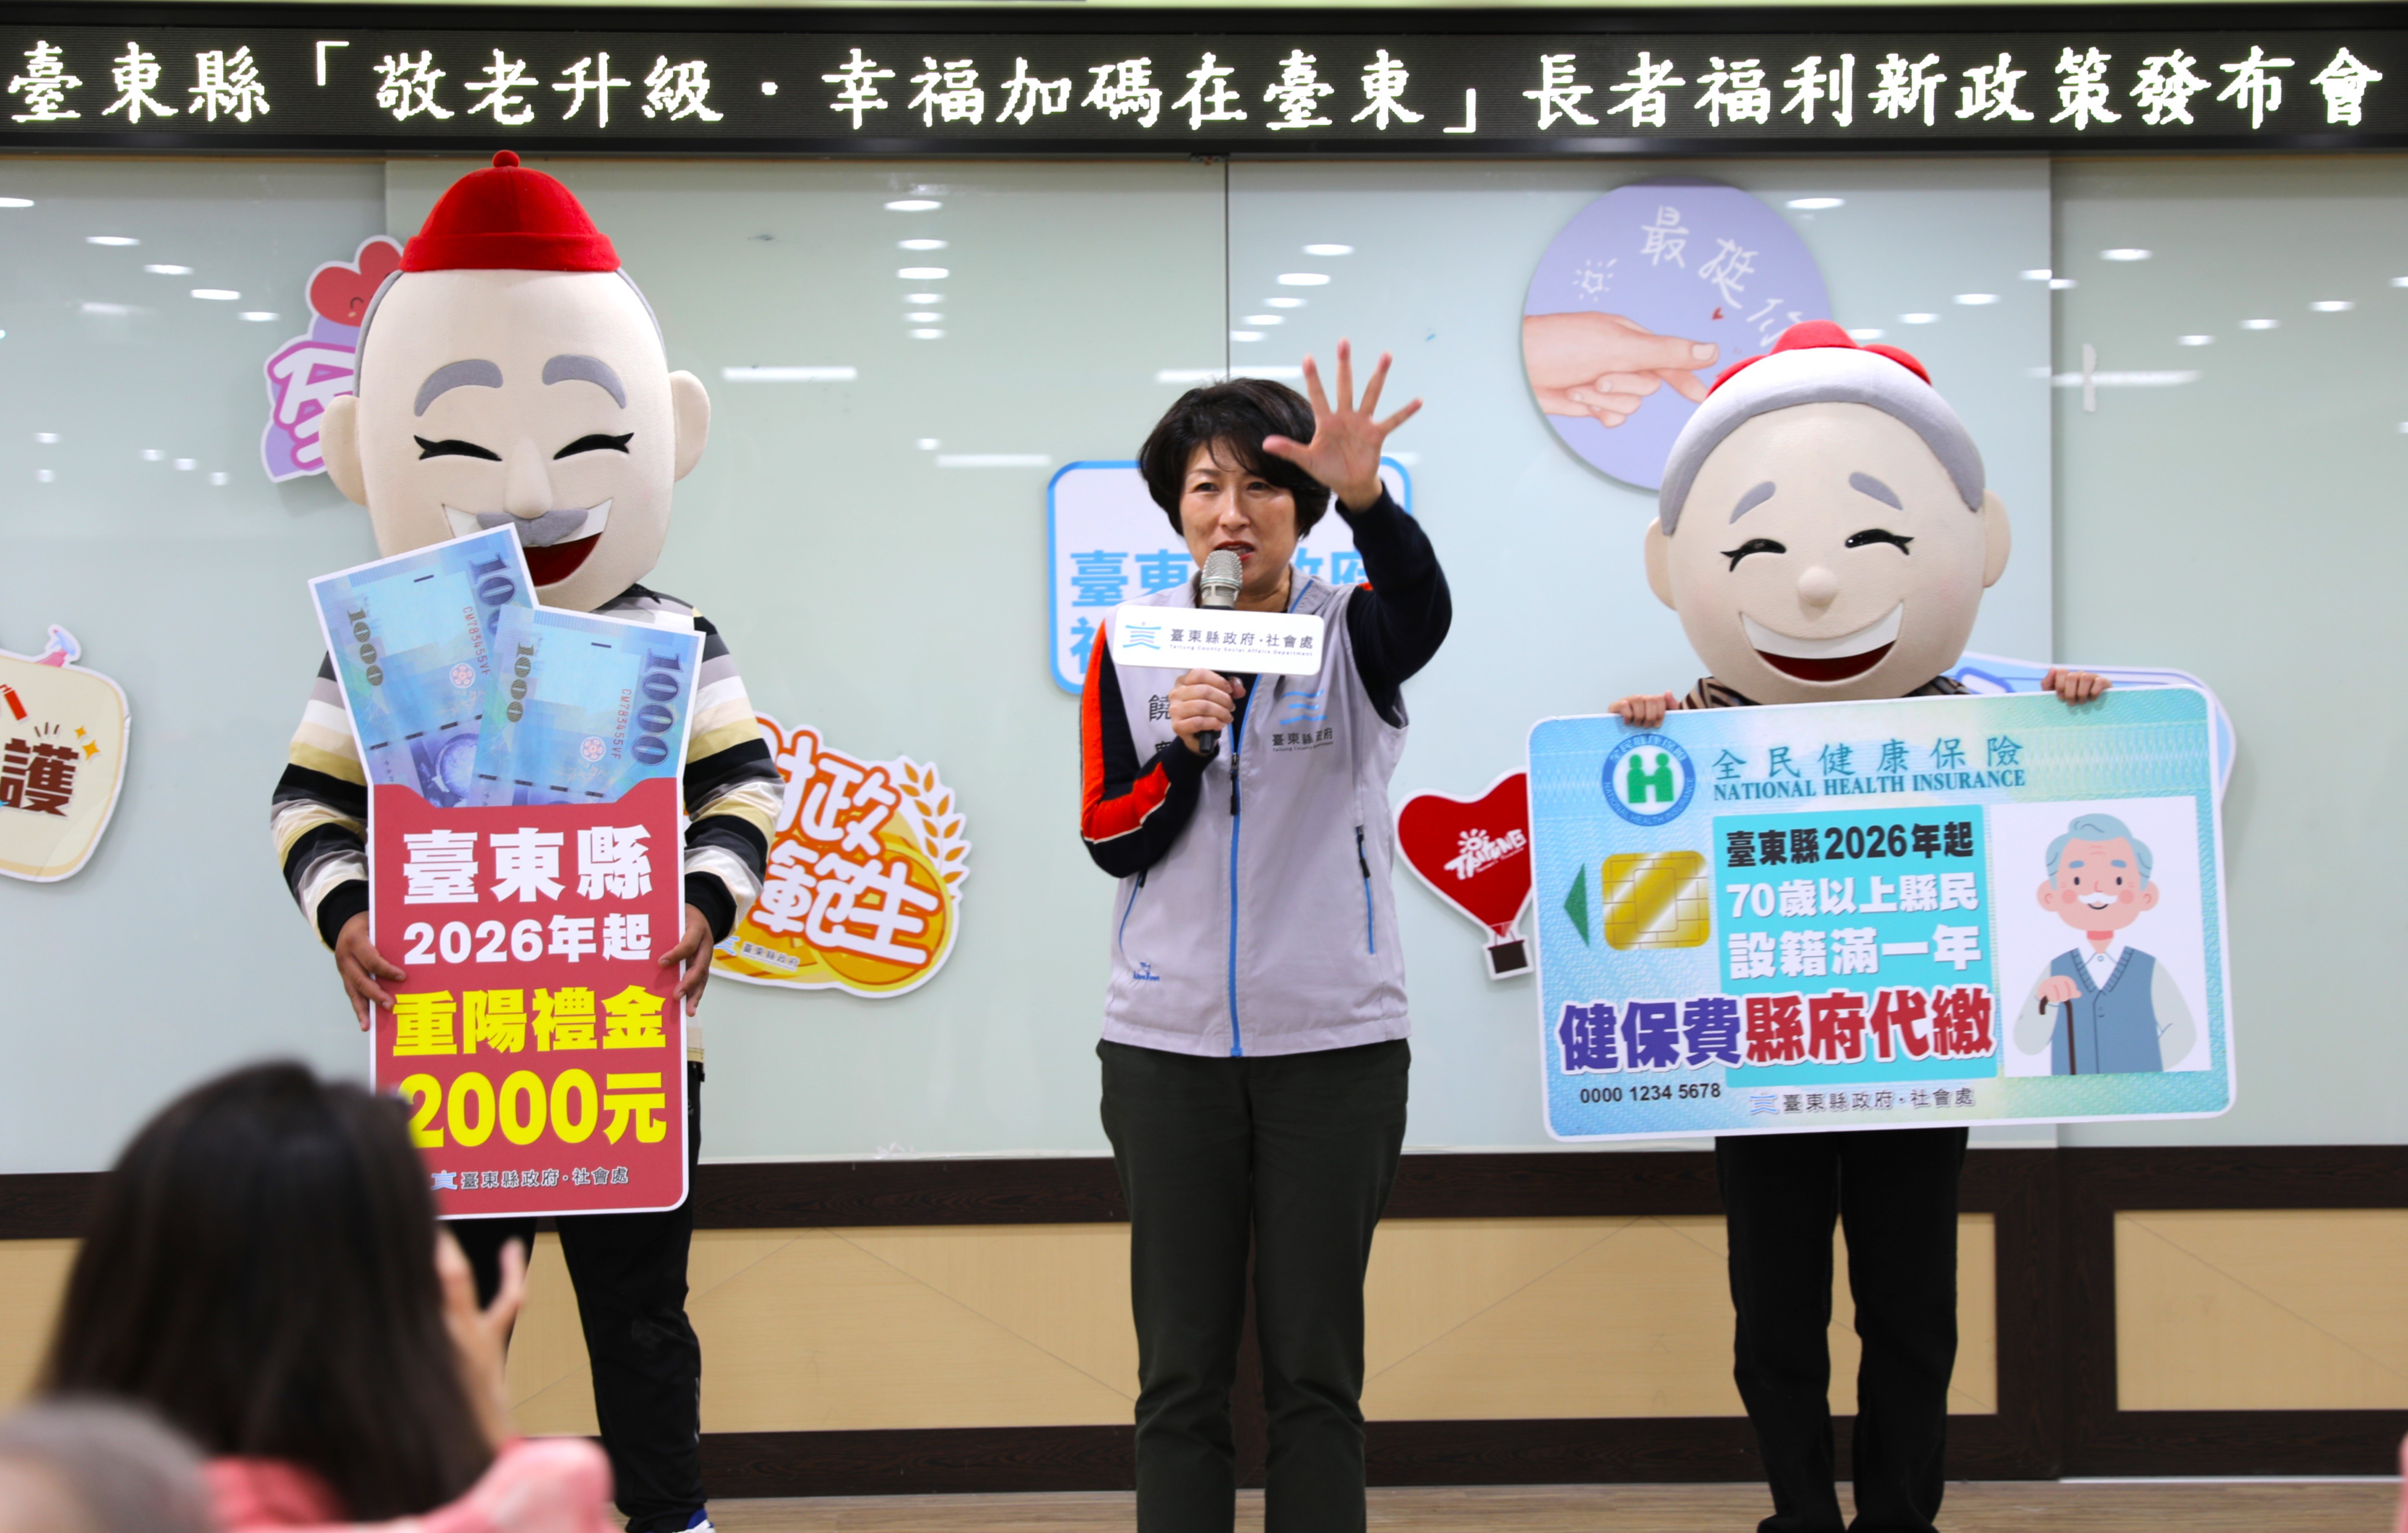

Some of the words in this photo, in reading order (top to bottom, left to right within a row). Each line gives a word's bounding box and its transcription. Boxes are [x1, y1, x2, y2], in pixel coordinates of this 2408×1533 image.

[347, 607, 383, 686] 1000
[507, 642, 534, 723] 1000
[631, 648, 683, 766] 1000
[1712, 735, 2023, 780] 全民健康保險
[1714, 780, 1816, 801] NATIONAL
[1824, 774, 1904, 796] HEALTH
[1913, 769, 2026, 791] INSURANCE
[404, 824, 653, 904] 臺東縣
[1727, 822, 1973, 867] 臺東縣2026年起
[1726, 872, 1978, 918] 70歲以上縣民
[403, 913, 651, 964] 2026年起
[1728, 924, 1982, 979] 設籍滿一年
[392, 985, 666, 1056] 重陽禮金
[1559, 987, 1993, 1071] 健保費縣府代繳
[398, 1068, 667, 1148] 2000元
[1580, 1086, 1622, 1104] 0000
[1630, 1084, 1672, 1102] 1234
[1678, 1082, 1721, 1100] 5678
